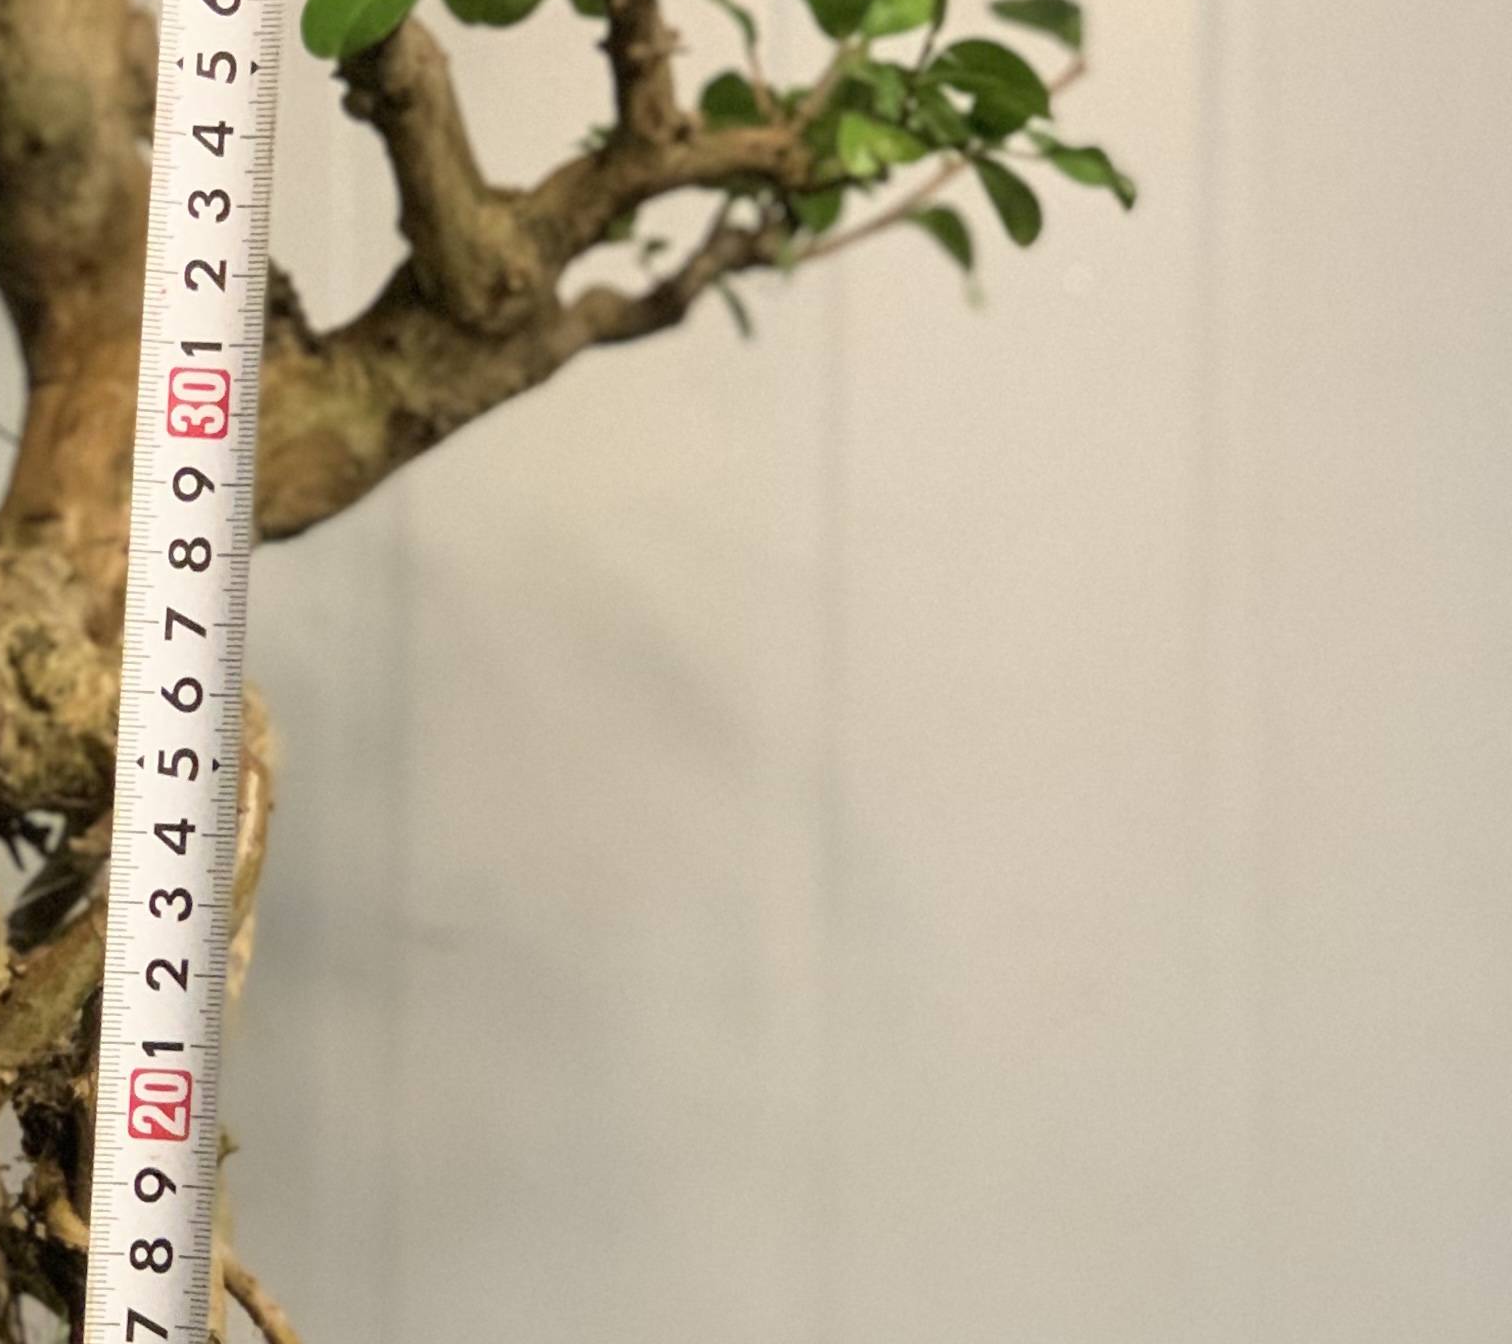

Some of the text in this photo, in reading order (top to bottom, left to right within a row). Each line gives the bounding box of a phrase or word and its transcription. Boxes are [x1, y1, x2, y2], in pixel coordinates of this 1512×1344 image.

[197, 51, 237, 84] 5
[193, 121, 234, 157] 4
[188, 189, 231, 223] 3
[185, 260, 227, 292] 2
[181, 341, 222, 356] 1
[170, 371, 226, 435] 30
[173, 467, 215, 502] 9
[169, 537, 212, 572] 8
[165, 607, 207, 640] 7
[161, 677, 203, 713] 6
[158, 748, 199, 781] 5
[154, 818, 196, 855] 4
[149, 888, 193, 922] 3
[146, 959, 189, 992] 2
[142, 1041, 184, 1057] 1
[131, 1072, 188, 1138] 20
[134, 1167, 177, 1203] 9
[130, 1238, 173, 1274] 8
[126, 1308, 168, 1343] 7
